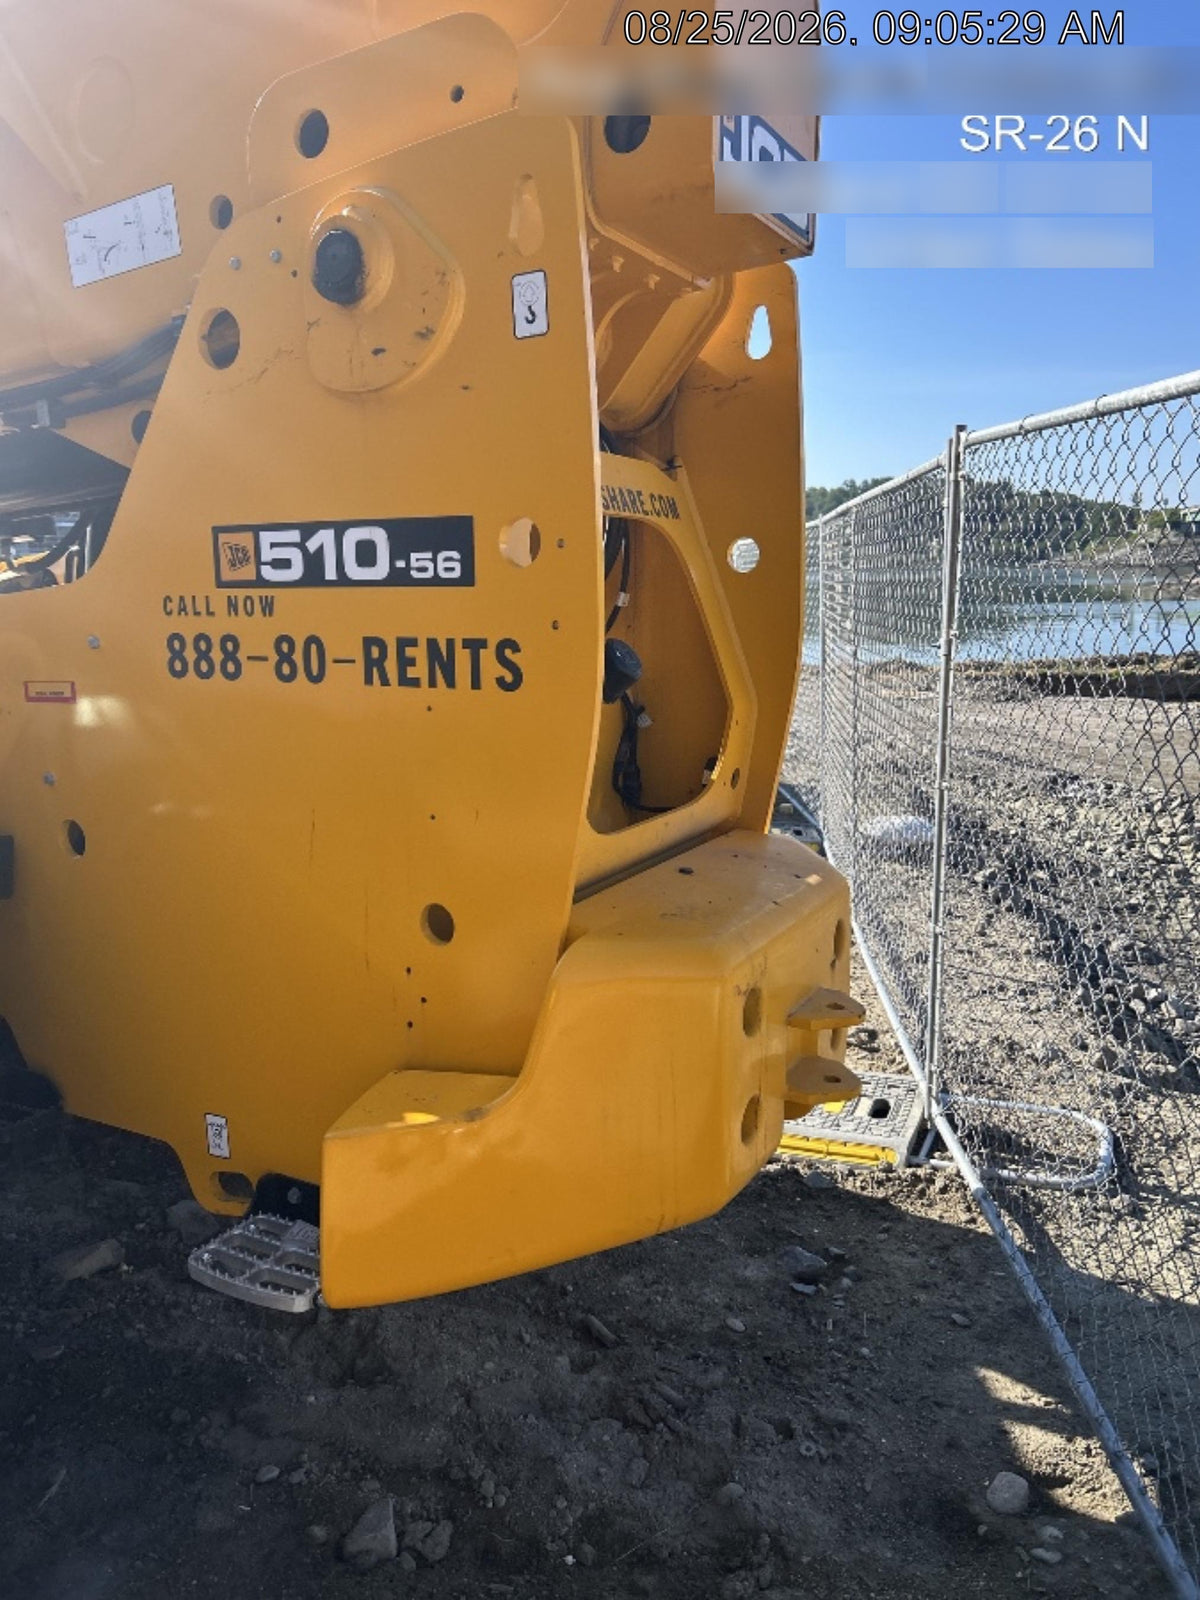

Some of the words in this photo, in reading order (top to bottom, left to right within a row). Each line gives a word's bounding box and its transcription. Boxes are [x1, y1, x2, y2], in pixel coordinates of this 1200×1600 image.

[258, 526, 462, 582] 510-56
[162, 595, 216, 617] CALL
[226, 595, 276, 617] NOW
[166, 632, 524, 692] 888-80-RENTS
